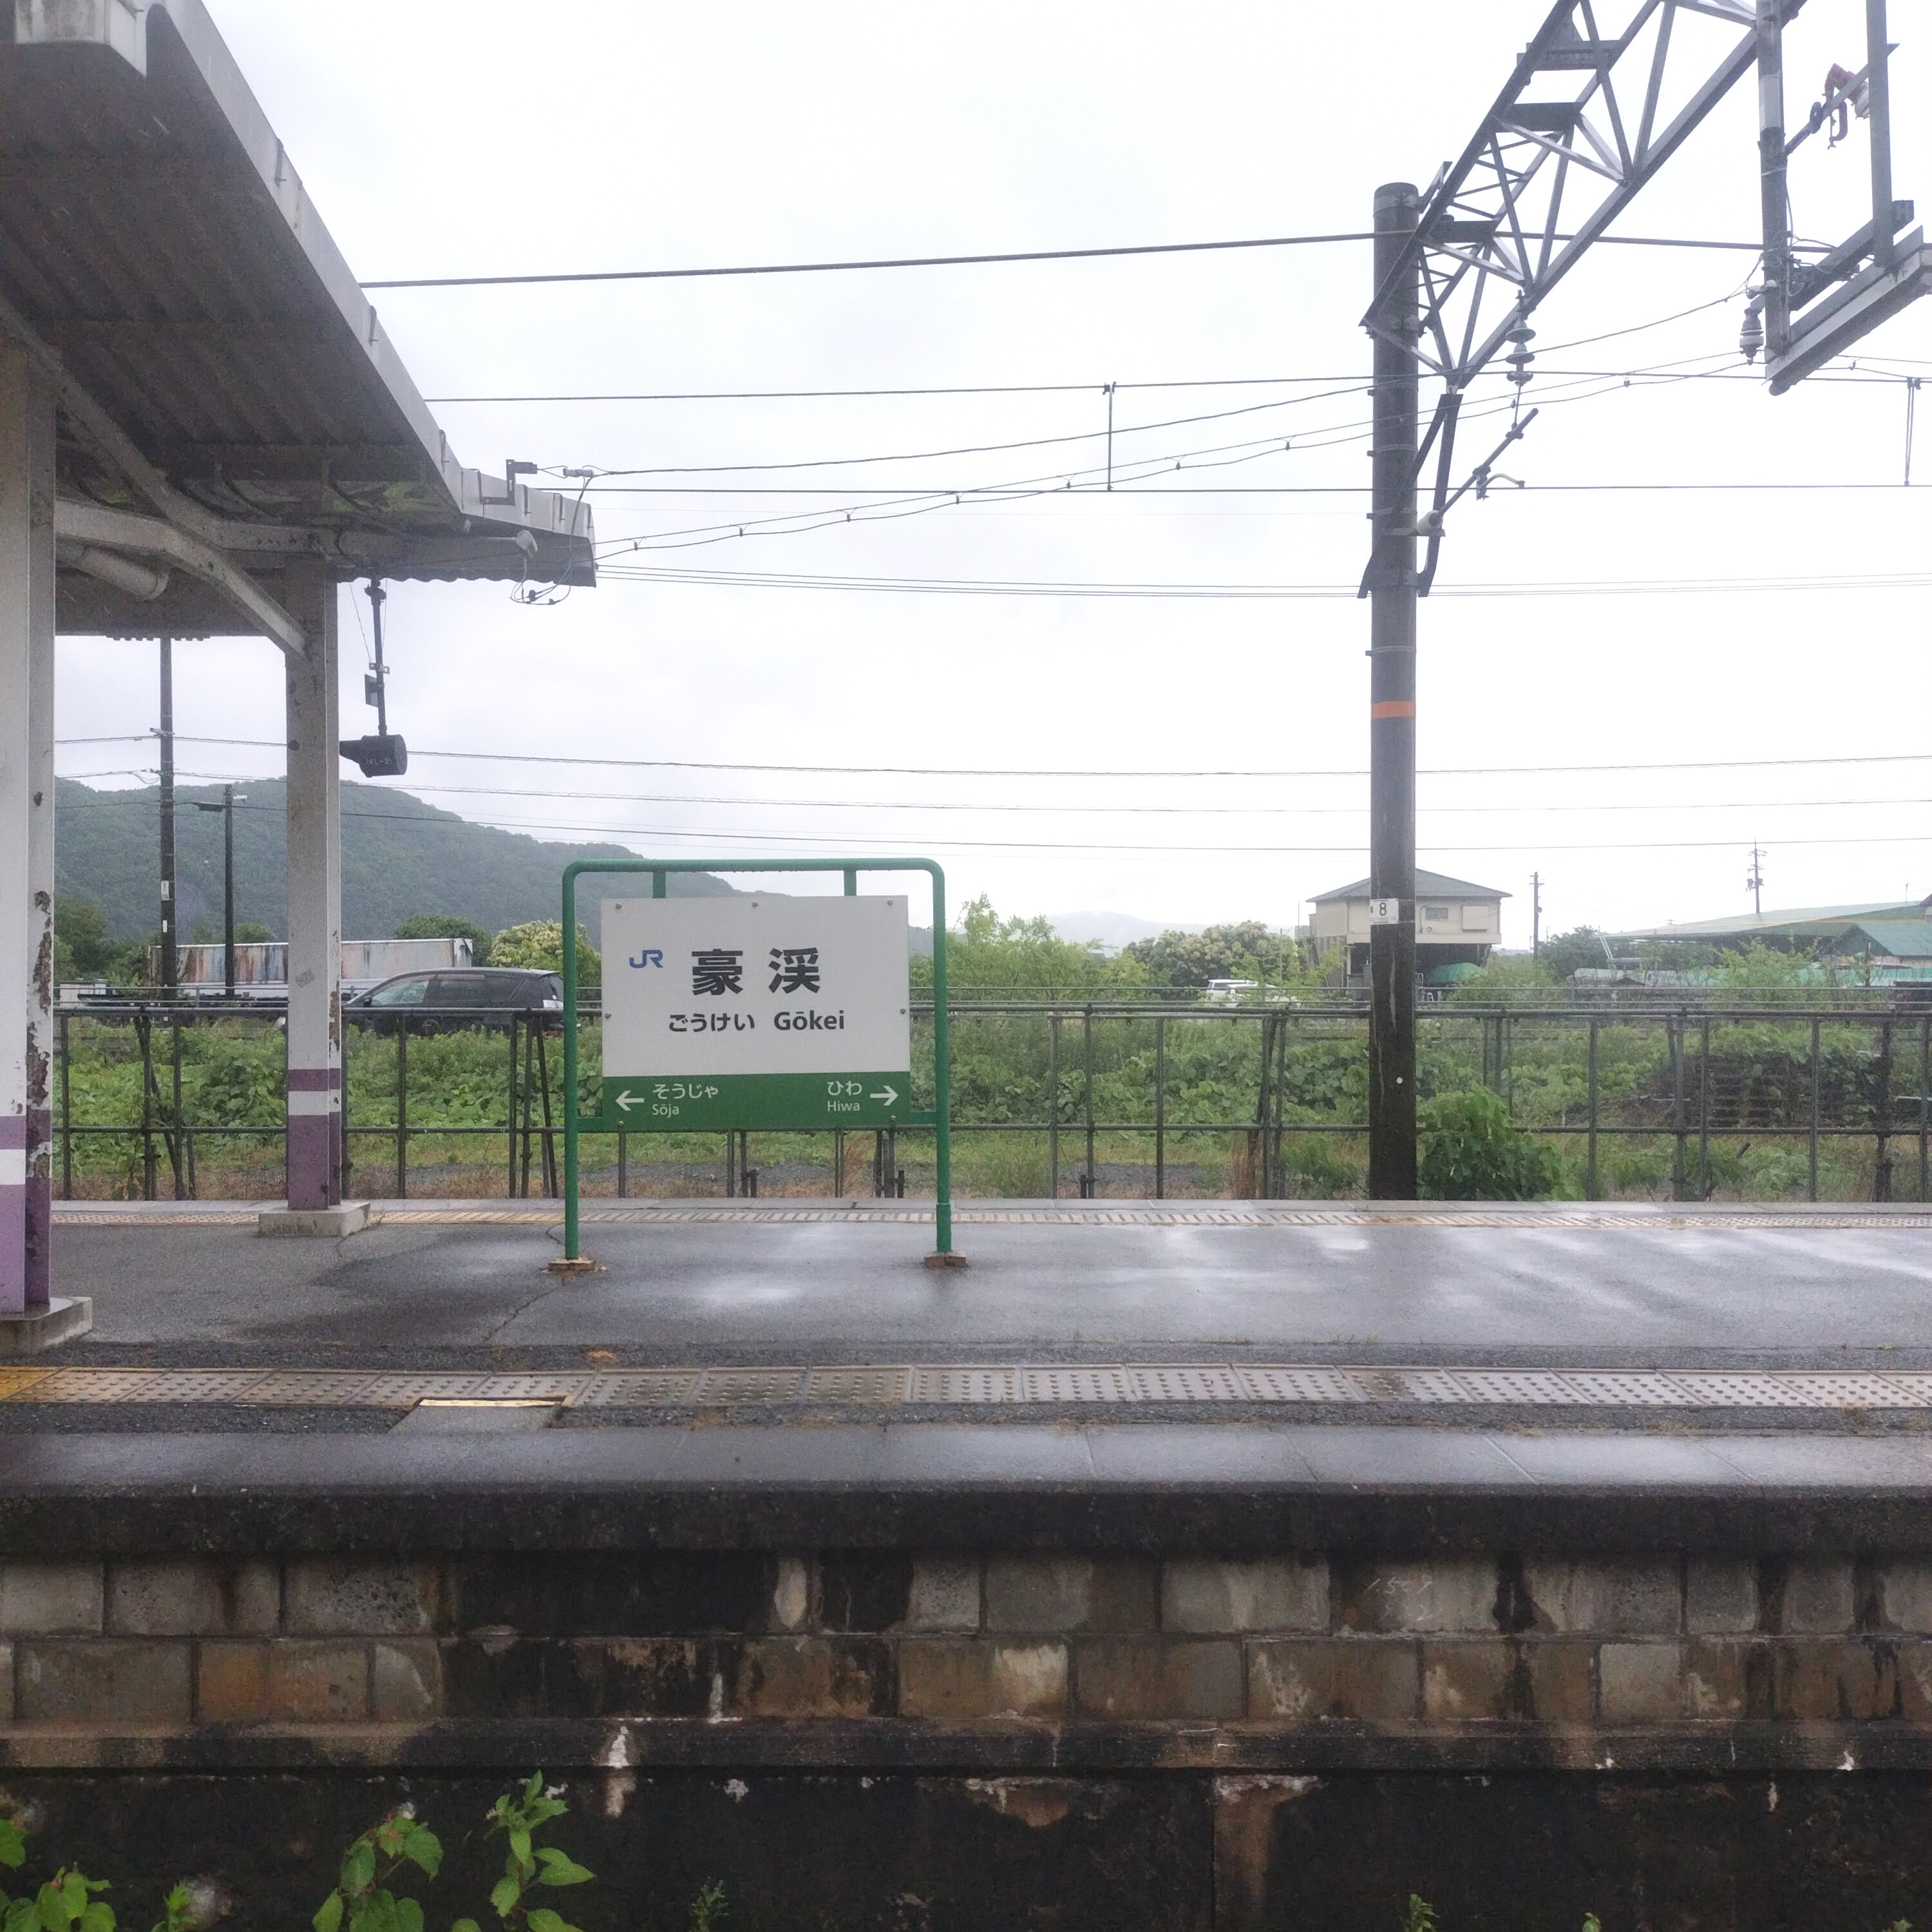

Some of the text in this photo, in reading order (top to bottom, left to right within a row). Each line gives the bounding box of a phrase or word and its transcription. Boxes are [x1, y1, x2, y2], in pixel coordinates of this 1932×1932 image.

[1379, 902, 1387, 916] 8
[629, 949, 663, 969] JR
[691, 947, 820, 996] 豪渓
[668, 1009, 844, 1033] ごうけい Gōkei
[652, 1083, 719, 1099] そうじゃ
[828, 1081, 862, 1096] ひわ
[652, 1103, 679, 1118] Sōja
[828, 1101, 860, 1112] Hiwa
